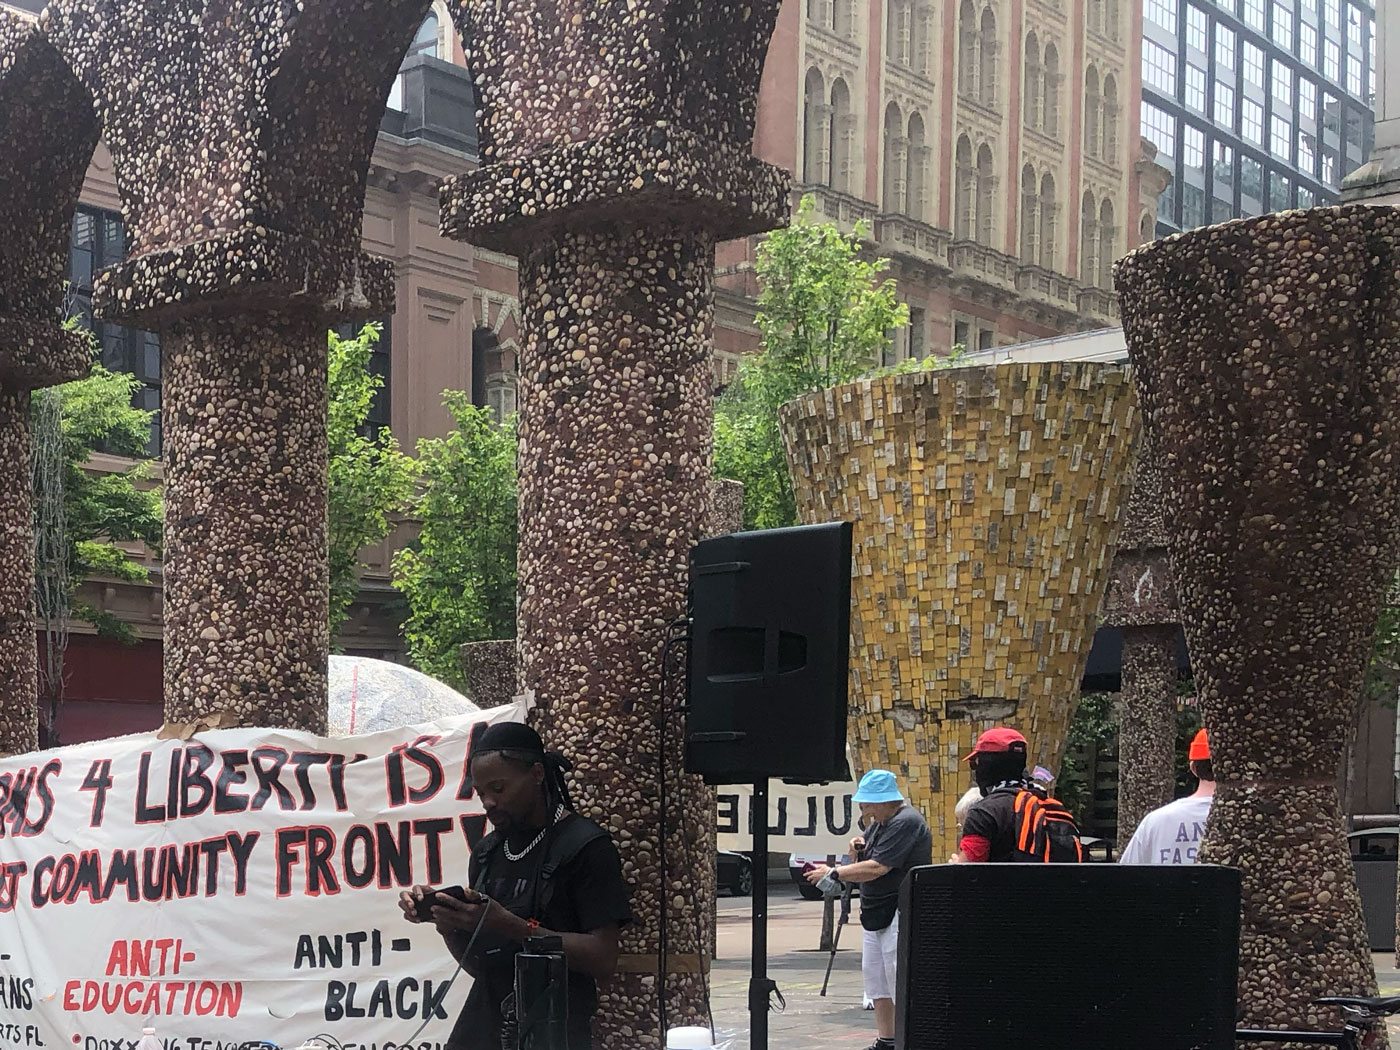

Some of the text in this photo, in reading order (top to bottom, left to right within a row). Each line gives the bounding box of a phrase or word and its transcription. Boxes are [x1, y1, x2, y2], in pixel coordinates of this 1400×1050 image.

[78, 759, 113, 828] 4
[385, 734, 445, 809] IS
[31, 830, 261, 909] COMMUNITY
[275, 816, 454, 899] FRONT
[105, 939, 196, 977] ANTI-
[293, 929, 411, 969] ANTI-
[62, 980, 243, 1018] EDUCATION
[324, 976, 450, 1022] BLACK
